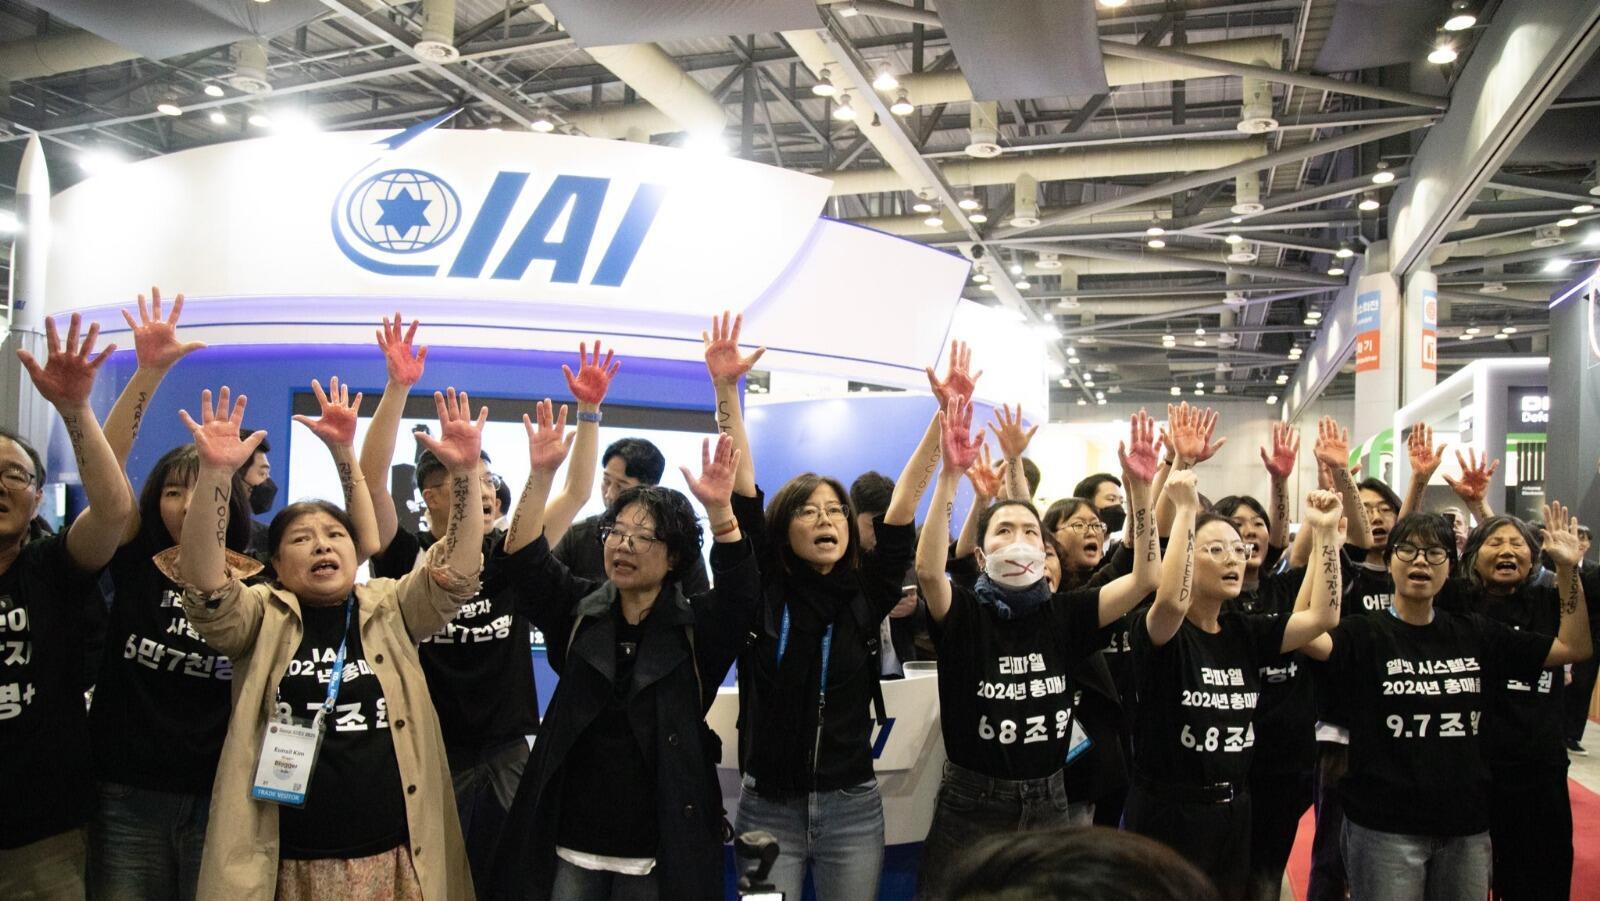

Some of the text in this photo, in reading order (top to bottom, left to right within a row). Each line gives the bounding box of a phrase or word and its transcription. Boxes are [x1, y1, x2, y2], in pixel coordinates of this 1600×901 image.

[447, 171, 668, 287] IAI
[214, 486, 230, 548] NOOR
[1322, 545, 1339, 611] 전쟁장사
[456, 598, 492, 619] 망자
[998, 653, 1047, 675] 리파엘
[1201, 667, 1245, 686] 리파엘
[977, 680, 1027, 701] 2024년
[1382, 679, 1441, 696] 2024년
[1181, 689, 1230, 710] 2024년
[1386, 714, 1431, 738] 9.7
[1180, 724, 1219, 753] 6.8
[257, 788, 301, 801] TRADE VISITOR
